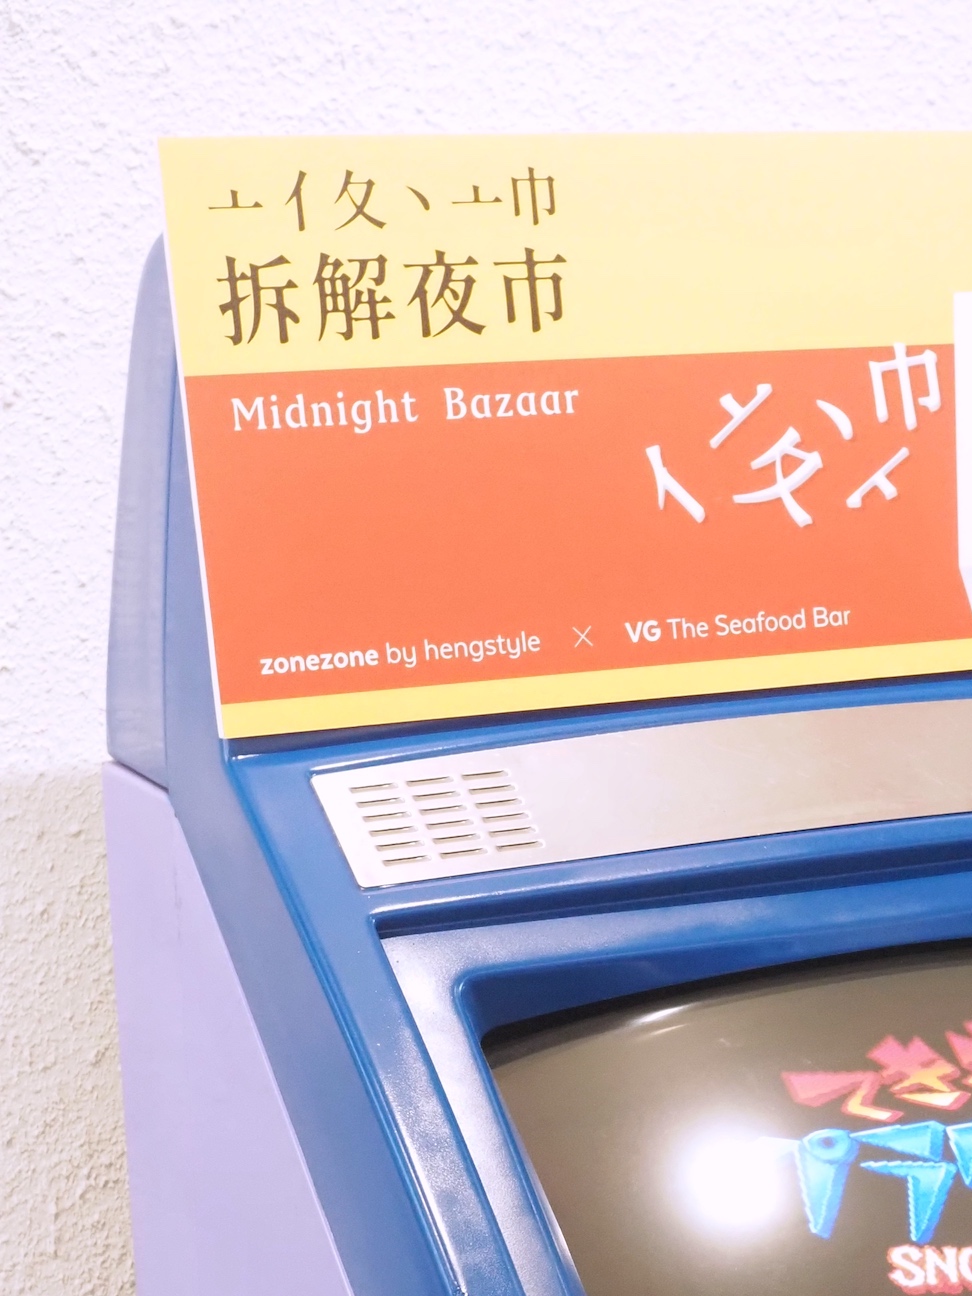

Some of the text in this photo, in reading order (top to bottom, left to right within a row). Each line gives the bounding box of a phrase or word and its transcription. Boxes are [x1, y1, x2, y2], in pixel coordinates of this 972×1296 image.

[216, 247, 568, 347] 拆解夜市
[230, 386, 580, 434] Midnight Bazaar
[624, 606, 852, 643] VG The Seafood Bar
[259, 630, 542, 675] zonezone by hengstyle
